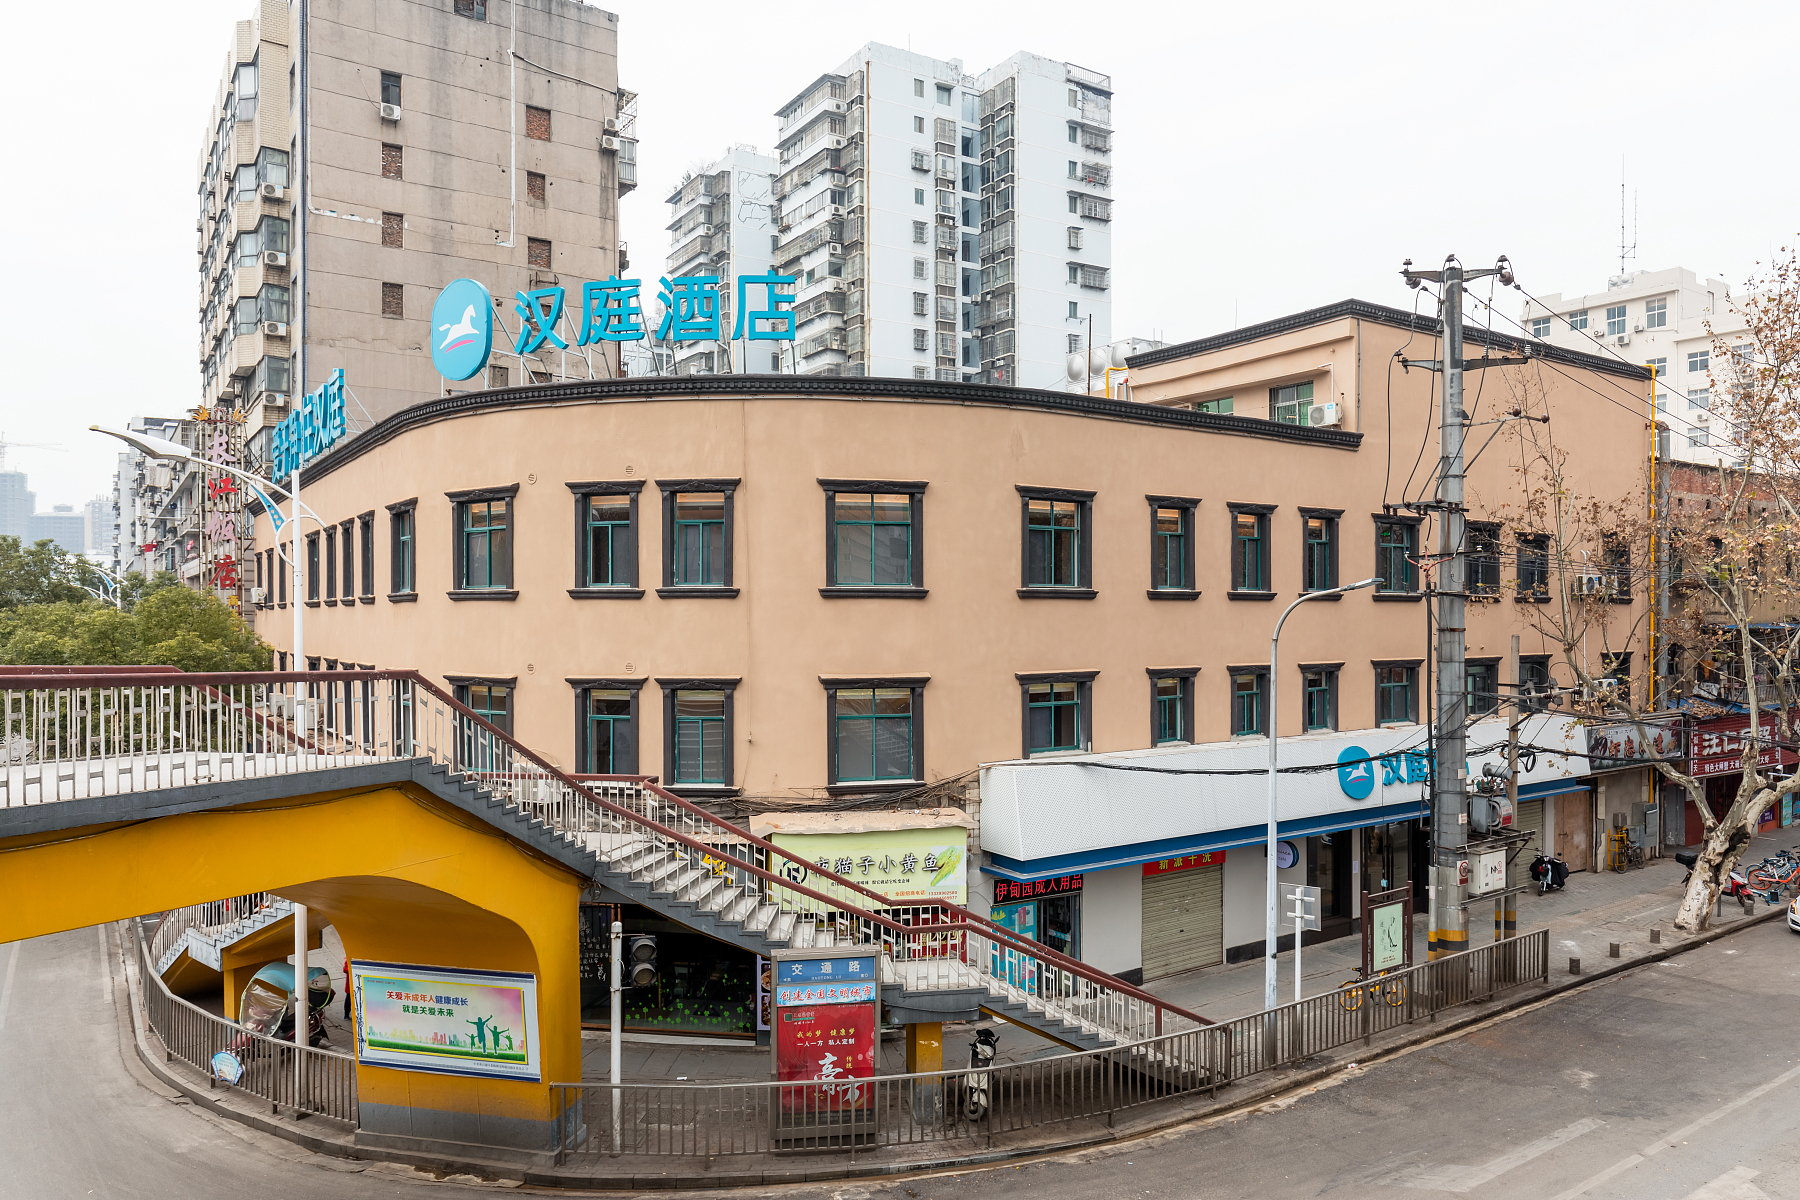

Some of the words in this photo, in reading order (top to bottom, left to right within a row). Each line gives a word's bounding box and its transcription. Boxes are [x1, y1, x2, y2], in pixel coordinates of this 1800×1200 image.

[514, 270, 796, 355] 汉庭酒店
[205, 430, 238, 589] 长江饭店
[811, 853, 940, 877] 夜猫子小黄鱼
[995, 873, 1082, 902] 伊甸园成人用品
[791, 960, 860, 975] 交通路
[386, 990, 469, 1007] 关爱未成年人健康成长
[779, 985, 873, 1002] 创建全国文明城市
[402, 1004, 455, 1018] 就是关爱未来
[797, 1029, 822, 1039] 我的梦
[829, 1027, 855, 1037] 健康梦
